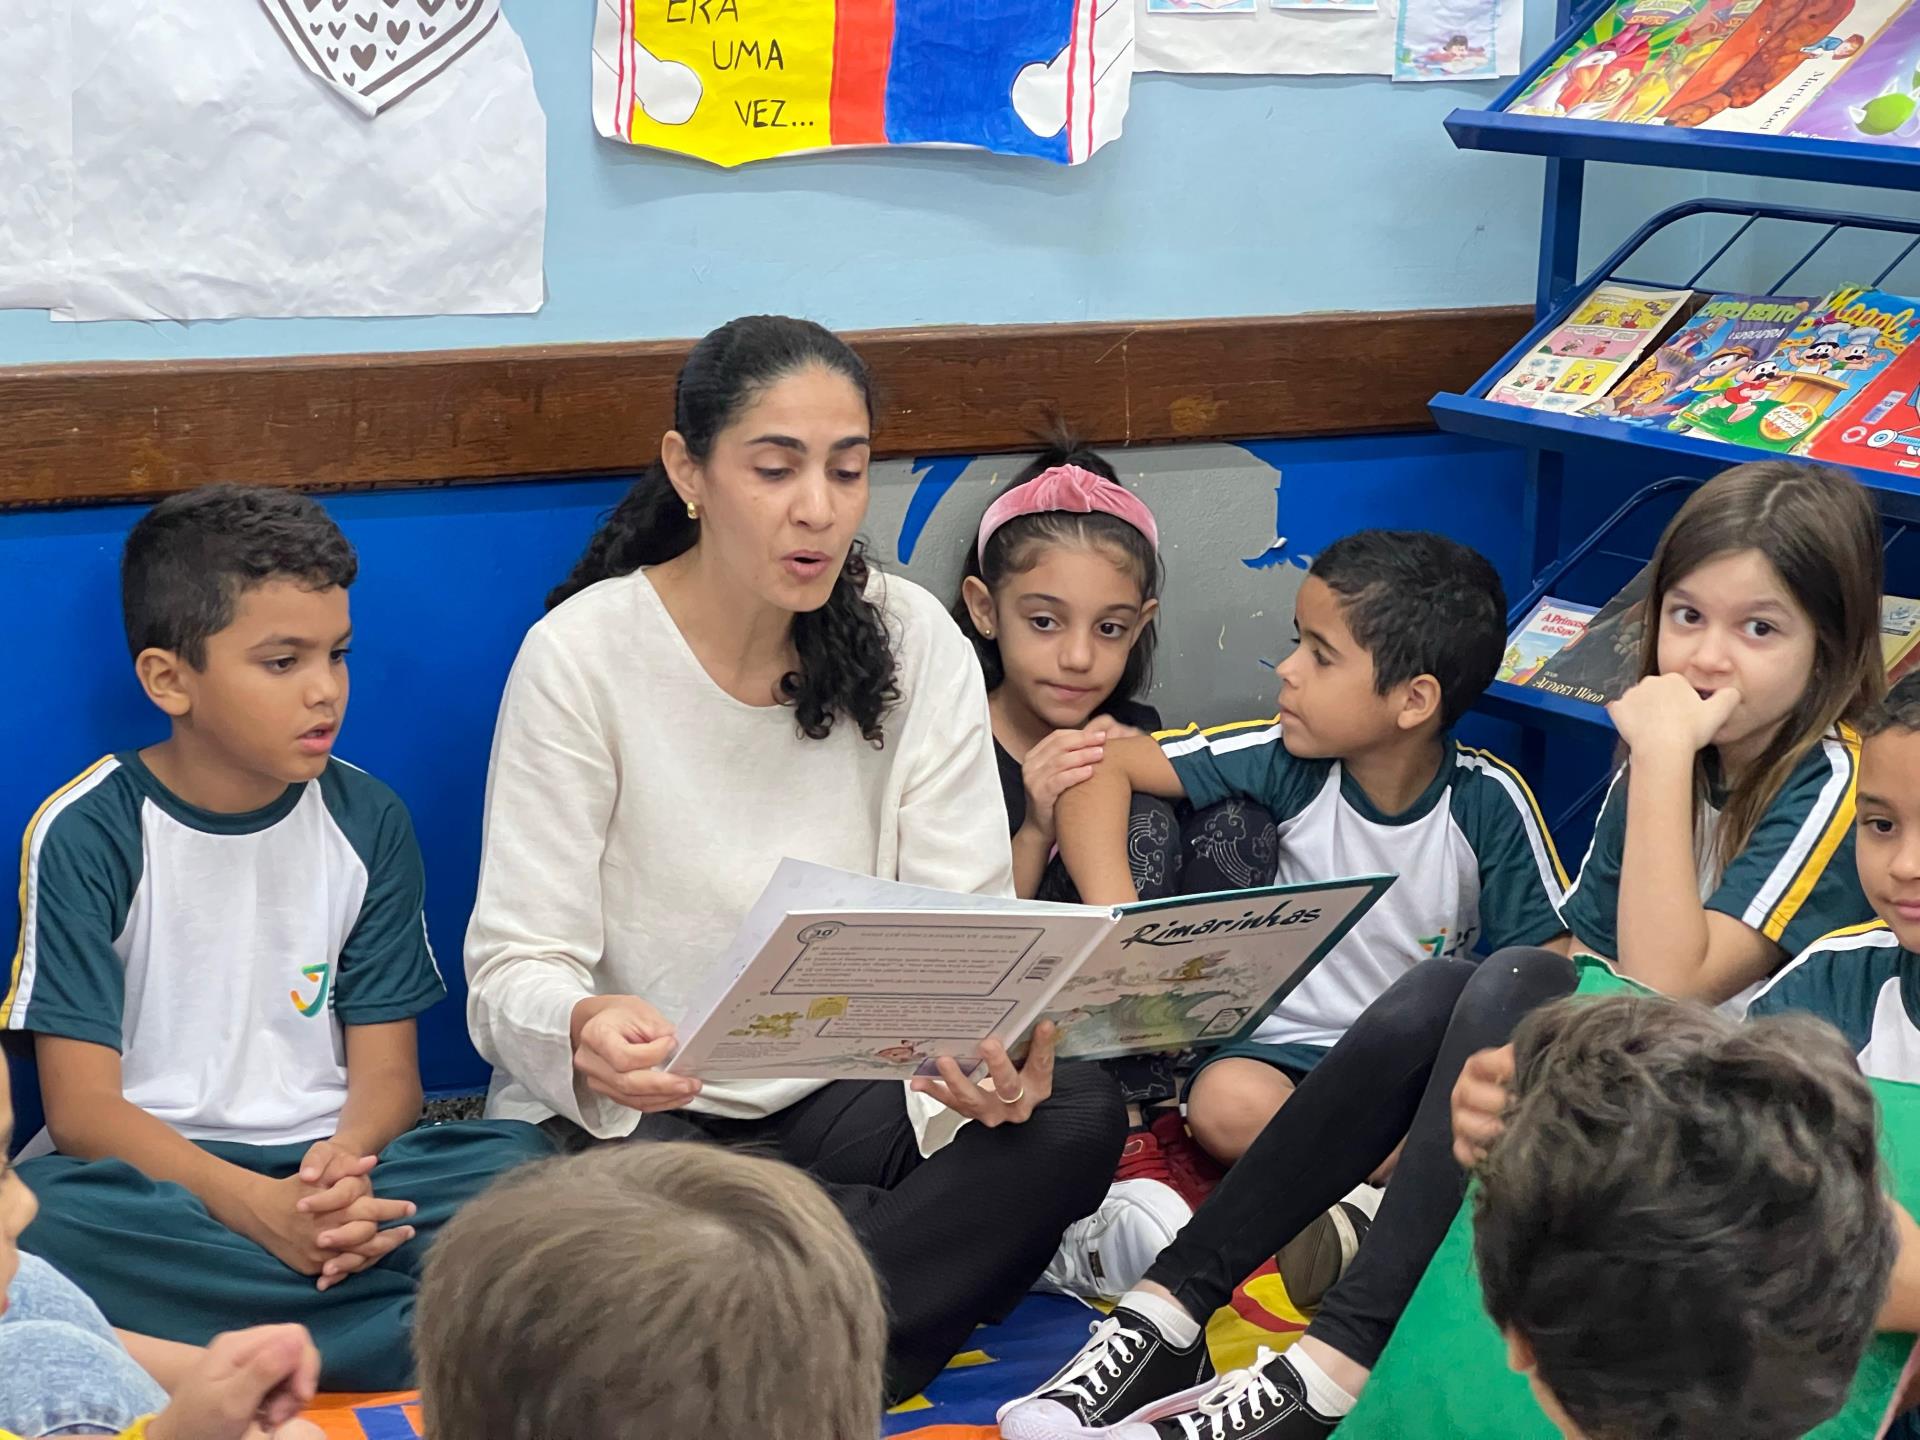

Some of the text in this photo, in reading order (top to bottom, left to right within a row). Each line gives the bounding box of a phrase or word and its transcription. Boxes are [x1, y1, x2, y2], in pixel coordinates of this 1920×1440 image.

[712, 39, 784, 71] UMA
[734, 98, 815, 130] VEZ...
[1742, 302, 1801, 323] BENTO
[1541, 613, 1550, 622] A
[1121, 900, 1322, 949] Rimarinhas
